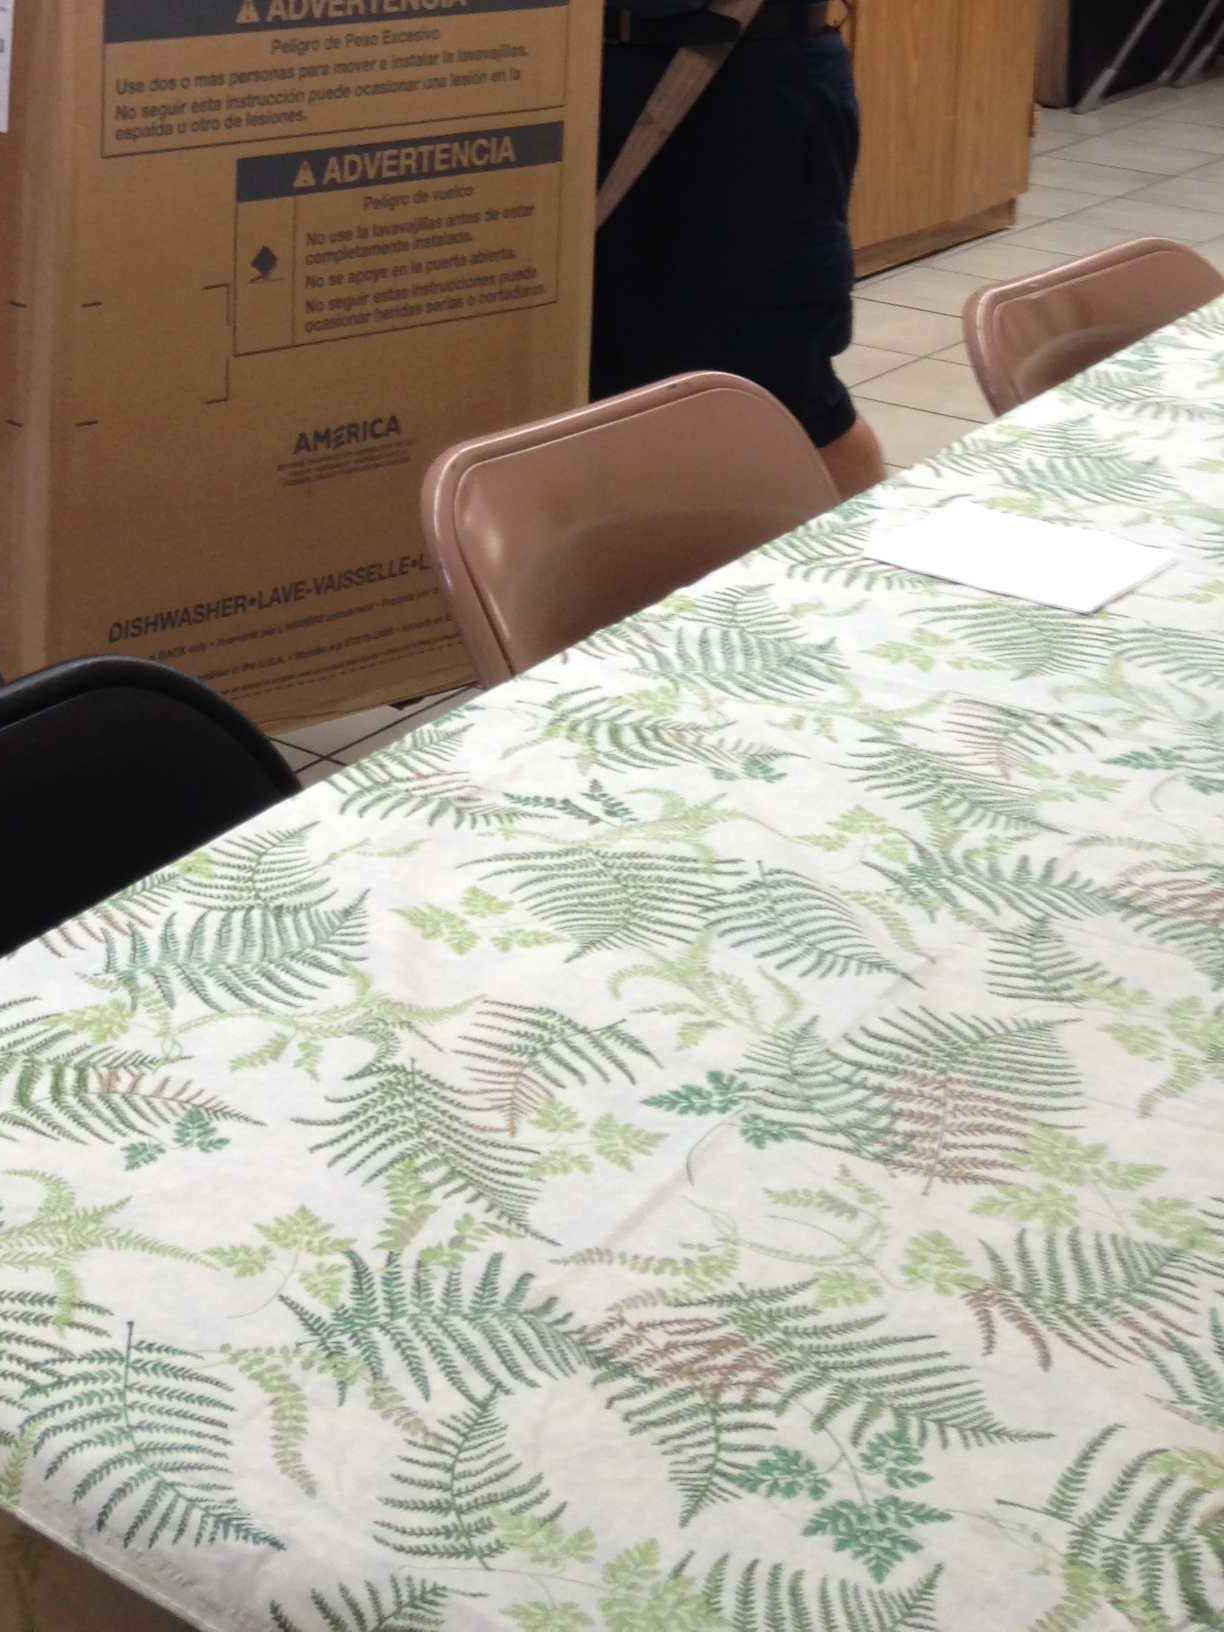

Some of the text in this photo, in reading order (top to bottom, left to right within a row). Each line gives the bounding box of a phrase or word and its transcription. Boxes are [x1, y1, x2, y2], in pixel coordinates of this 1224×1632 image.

[271, 27, 441, 56] Peligro de Peso Excesivo
[115, 79, 145, 95] Use
[150, 76, 177, 92] dos
[180, 76, 191, 89] o
[228, 66, 295, 87] personas
[298, 64, 330, 80] para
[334, 59, 376, 74] mover
[115, 106, 137, 121] No
[141, 100, 187, 120] seguir
[191, 97, 222, 113] esta
[226, 90, 305, 111] instrucción
[308, 85, 350, 105] puede
[354, 78, 420, 97] ocasionar
[423, 77, 446, 90] una
[490, 70, 507, 83] en
[509, 67, 521, 81] la
[115, 121, 174, 142] espalda
[177, 122, 187, 134] u
[191, 118, 221, 132] otro
[224, 115, 243, 129] de
[322, 136, 517, 187] ADVERTENCIA
[363, 185, 474, 211] Peligro de vuelco
[306, 230, 325, 246] No
[329, 228, 353, 243] use
[305, 274, 325, 290] No
[327, 272, 344, 286] se
[391, 264, 408, 278] en
[304, 298, 325, 314] No
[327, 292, 370, 312] seguir
[294, 415, 401, 455] AMERICA
[108, 593, 248, 644] DISHWASHER
[257, 555, 410, 610] LAVE-VAISSELLE
